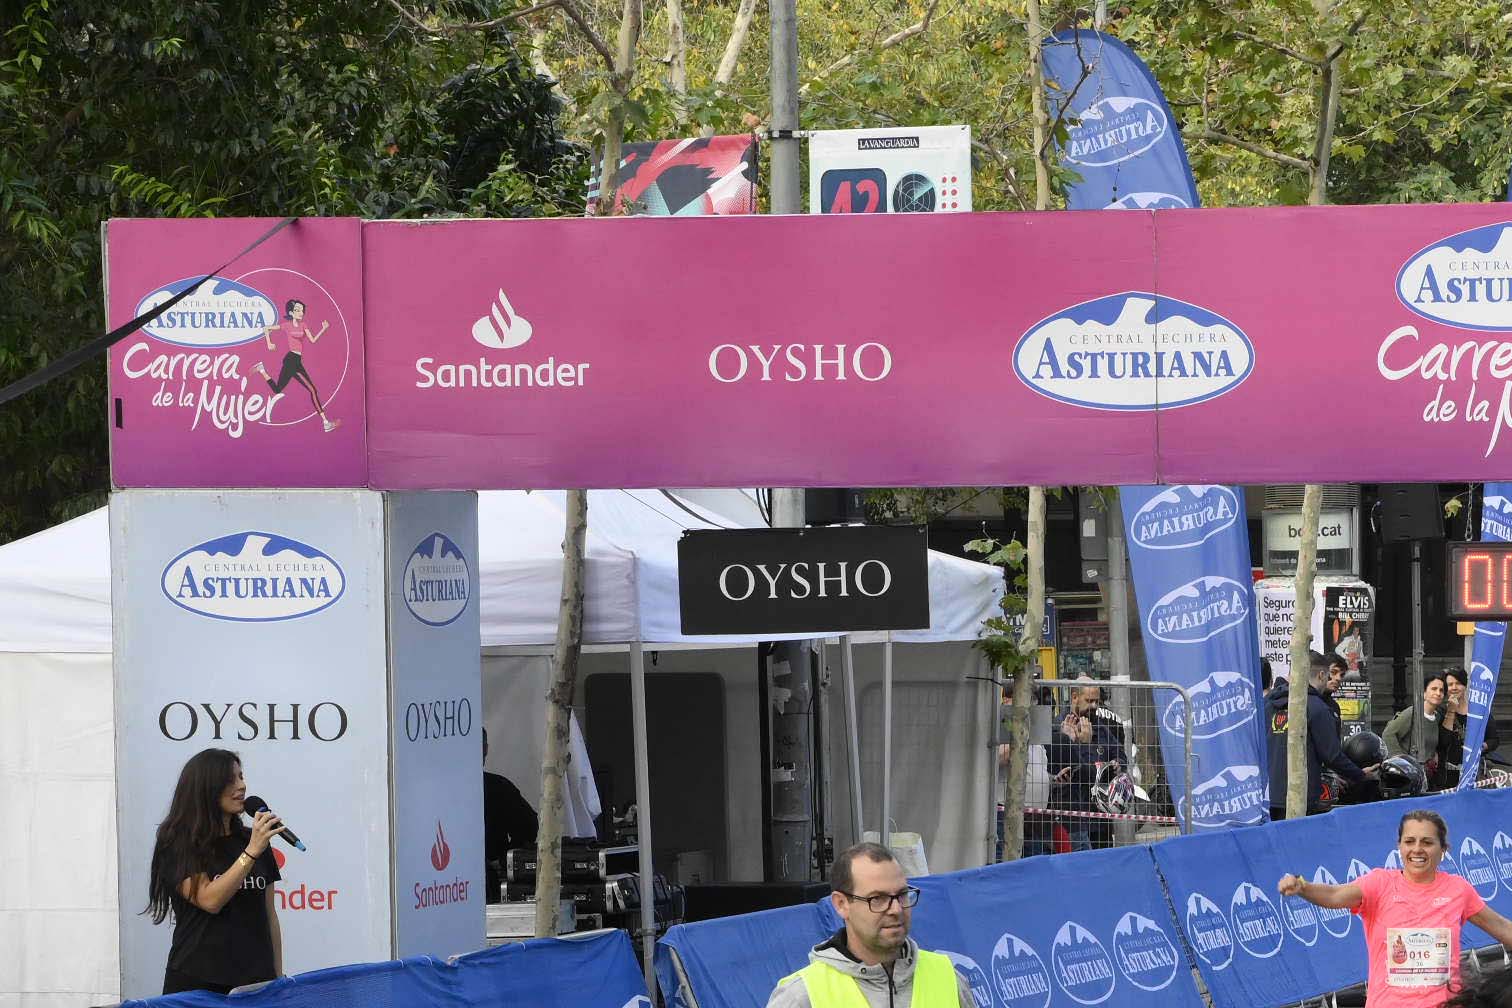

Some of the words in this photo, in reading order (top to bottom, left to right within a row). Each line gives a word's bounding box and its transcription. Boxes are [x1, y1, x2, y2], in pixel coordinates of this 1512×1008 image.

[147, 302, 266, 329] ASTURIANA
[173, 299, 212, 309] ENTRAL
[1068, 333, 1144, 345] CENTRAL
[1152, 332, 1228, 345] LECHERA
[123, 342, 241, 380] Carrera
[415, 356, 590, 389] Santander
[708, 342, 892, 383] OYSHO
[1032, 337, 1236, 380] ASTURIANA
[152, 381, 174, 407] de
[178, 382, 194, 408] la
[191, 376, 286, 439] Mujer
[1422, 384, 1458, 422] de
[1465, 382, 1490, 422] la
[1288, 524, 1342, 538] b.cat
[176, 566, 332, 600] ASTURIANA
[204, 562, 262, 573] CENTRAL
[268, 562, 327, 573] LECHERA
[718, 559, 892, 602] OYSHO
[409, 567, 466, 603] ASTURIANA
[1264, 612, 1281, 625] que
[1338, 595, 1369, 609] ELVIS
[1265, 653, 1284, 662] este
[158, 701, 349, 742] OYSHO
[405, 697, 472, 743] OYSHO
[414, 877, 470, 910] Santander
[996, 969, 1049, 1002] ASTURIANA
[1057, 954, 1113, 987] ASTURIANA
